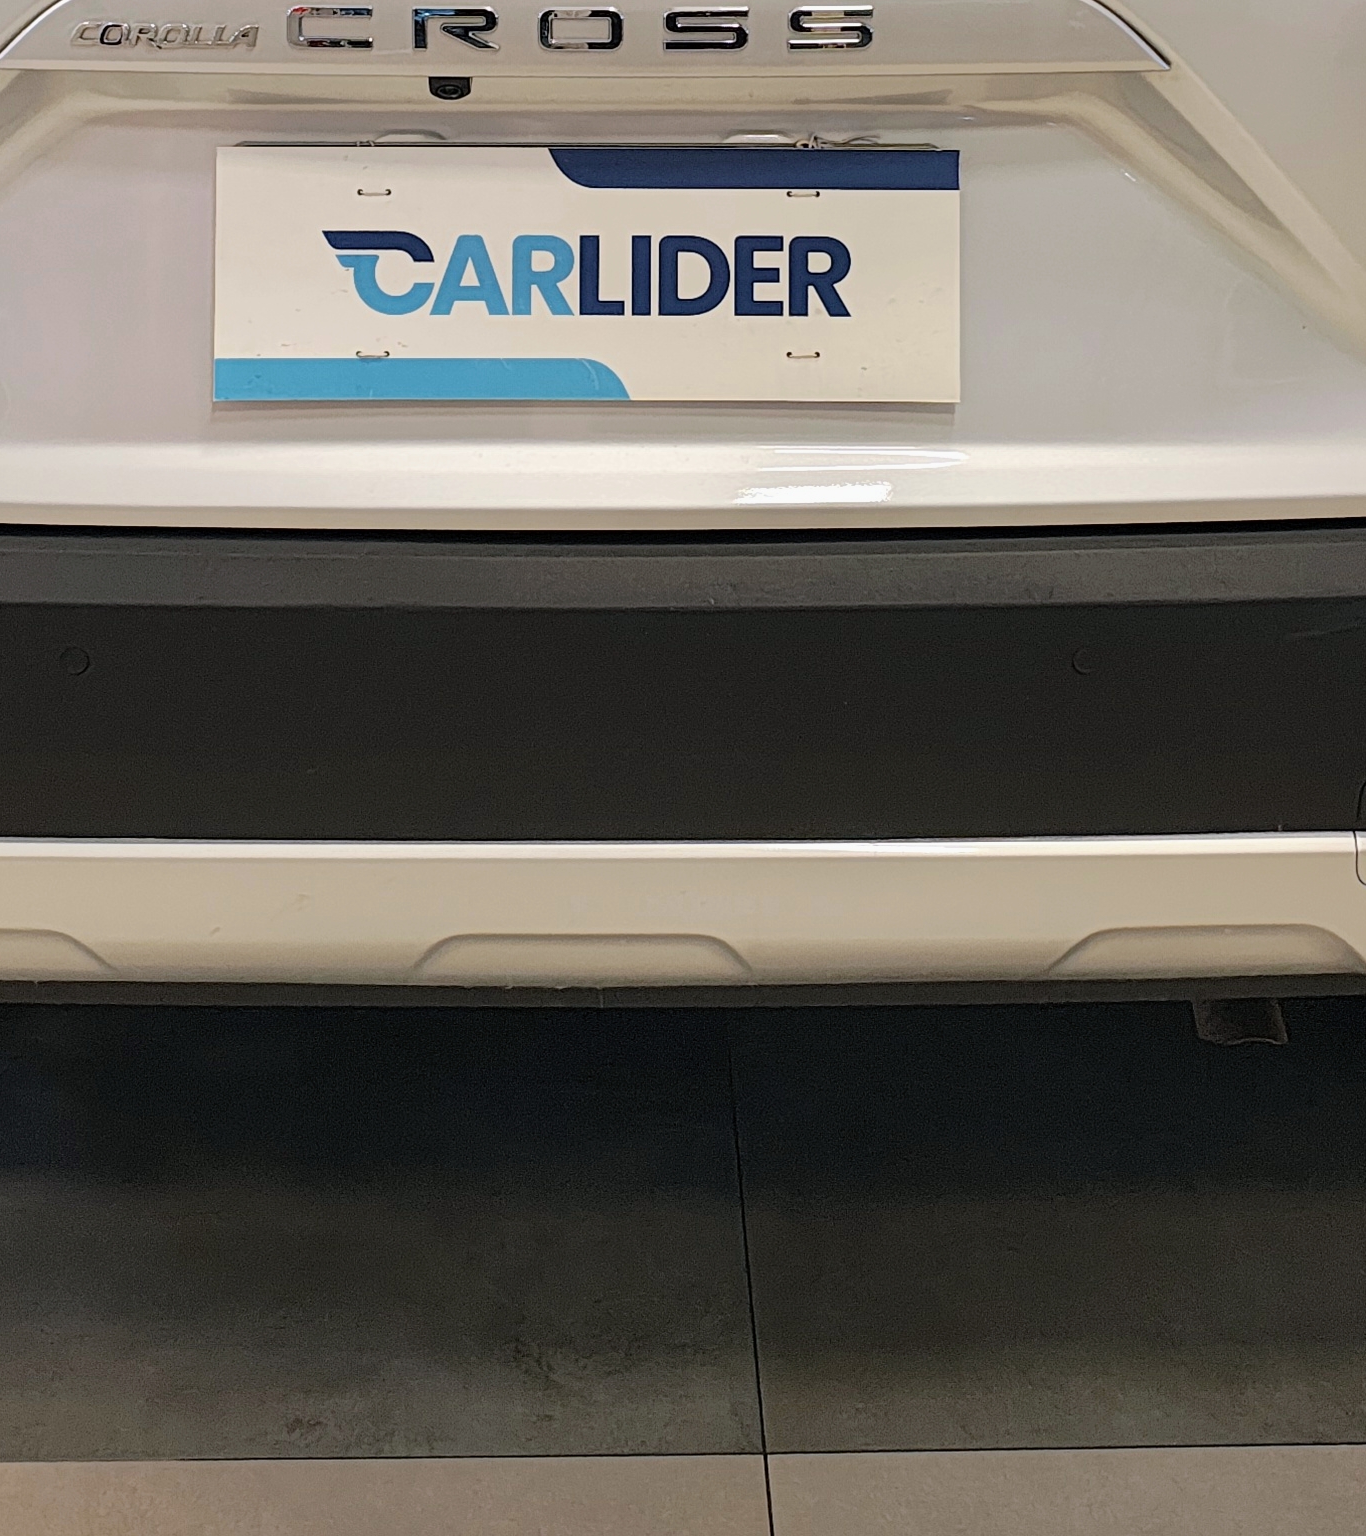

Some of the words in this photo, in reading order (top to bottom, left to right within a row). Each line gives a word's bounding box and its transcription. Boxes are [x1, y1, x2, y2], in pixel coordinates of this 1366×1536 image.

[69, 20, 261, 51] COROLLA
[286, 4, 876, 52] CROSS
[321, 229, 853, 318] CARLIDER
